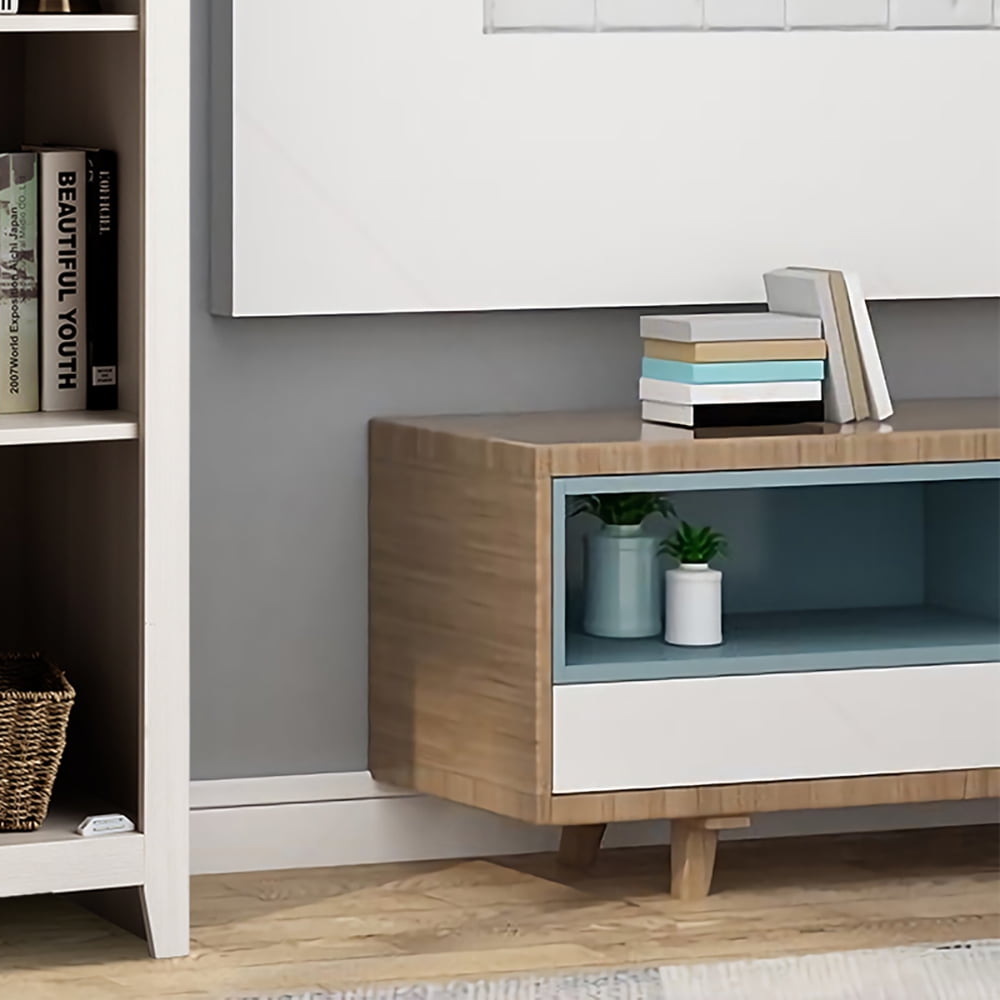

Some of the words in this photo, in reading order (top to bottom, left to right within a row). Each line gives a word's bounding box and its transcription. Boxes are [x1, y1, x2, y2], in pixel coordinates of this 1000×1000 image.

[9, 207, 19, 240] Japan
[58, 171, 77, 302] BEAUTIFUL
[58, 308, 77, 390] YOUTH
